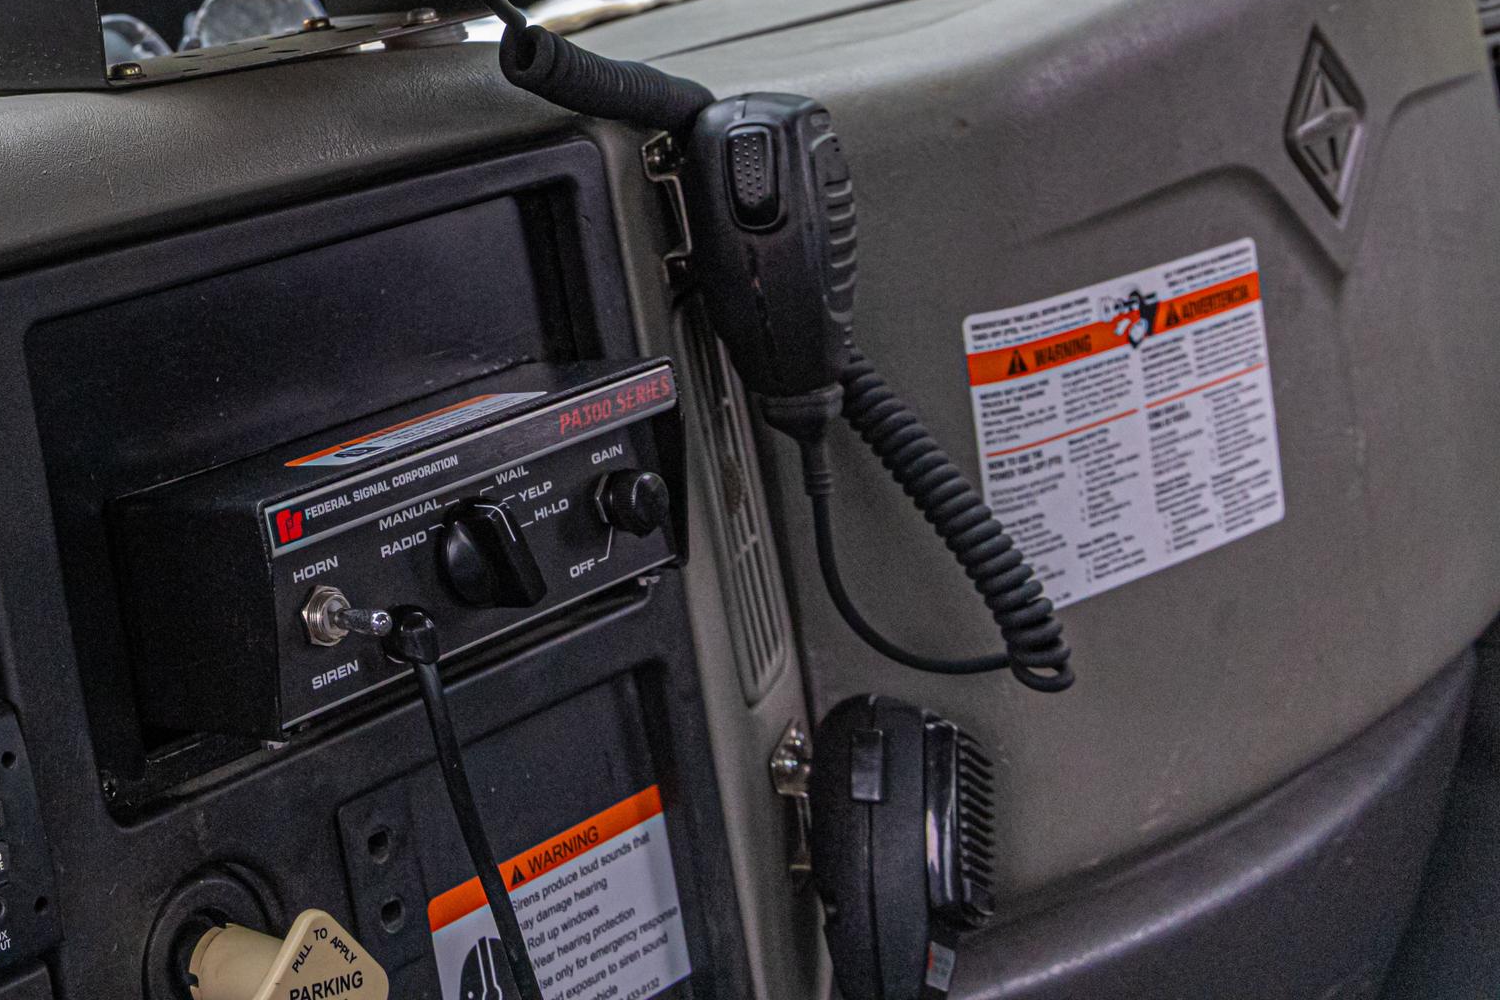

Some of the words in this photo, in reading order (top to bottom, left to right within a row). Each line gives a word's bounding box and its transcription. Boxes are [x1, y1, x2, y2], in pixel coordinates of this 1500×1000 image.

[1033, 334, 1092, 366] WARNING
[560, 398, 612, 435] PA300
[616, 375, 671, 413] SERIES
[591, 444, 623, 465] GAIN
[305, 494, 352, 520] FEDERAL
[353, 480, 391, 502] SIGNAL
[392, 454, 459, 488] CORPORATION
[495, 465, 530, 486] WAIL
[518, 481, 553, 502] YELP
[379, 499, 442, 531] MANUAL
[534, 498, 570, 521] HI-LO
[380, 531, 428, 558] RADIO
[293, 555, 339, 584] HORN
[569, 558, 596, 578] OFF
[311, 660, 359, 690] SIREN
[527, 825, 599, 875] WARNING
[512, 890, 541, 913] Sirens
[542, 870, 579, 898] produce
[579, 857, 600, 879] loud
[600, 840, 632, 866] sounds
[632, 830, 650, 850] that
[520, 917, 534, 931] ay
[536, 895, 573, 923] damage
[574, 876, 608, 904] hearing
[527, 931, 546, 951] Roll
[547, 926, 560, 942] up
[560, 904, 600, 933] windows
[557, 931, 592, 957] hearing
[592, 906, 636, 940] protection
[291, 943, 313, 974] PULL
[313, 927, 328, 942] TO
[330, 936, 357, 965] APPLY
[540, 976, 554, 990] se
[555, 962, 574, 982] only
[575, 953, 589, 970] for
[590, 928, 638, 963] emergency
[638, 905, 679, 934] response
[566, 968, 606, 999] exposure
[608, 962, 618, 976] to
[619, 949, 641, 969] siren
[642, 932, 669, 957] sound
[289, 970, 364, 1000] PARKING
